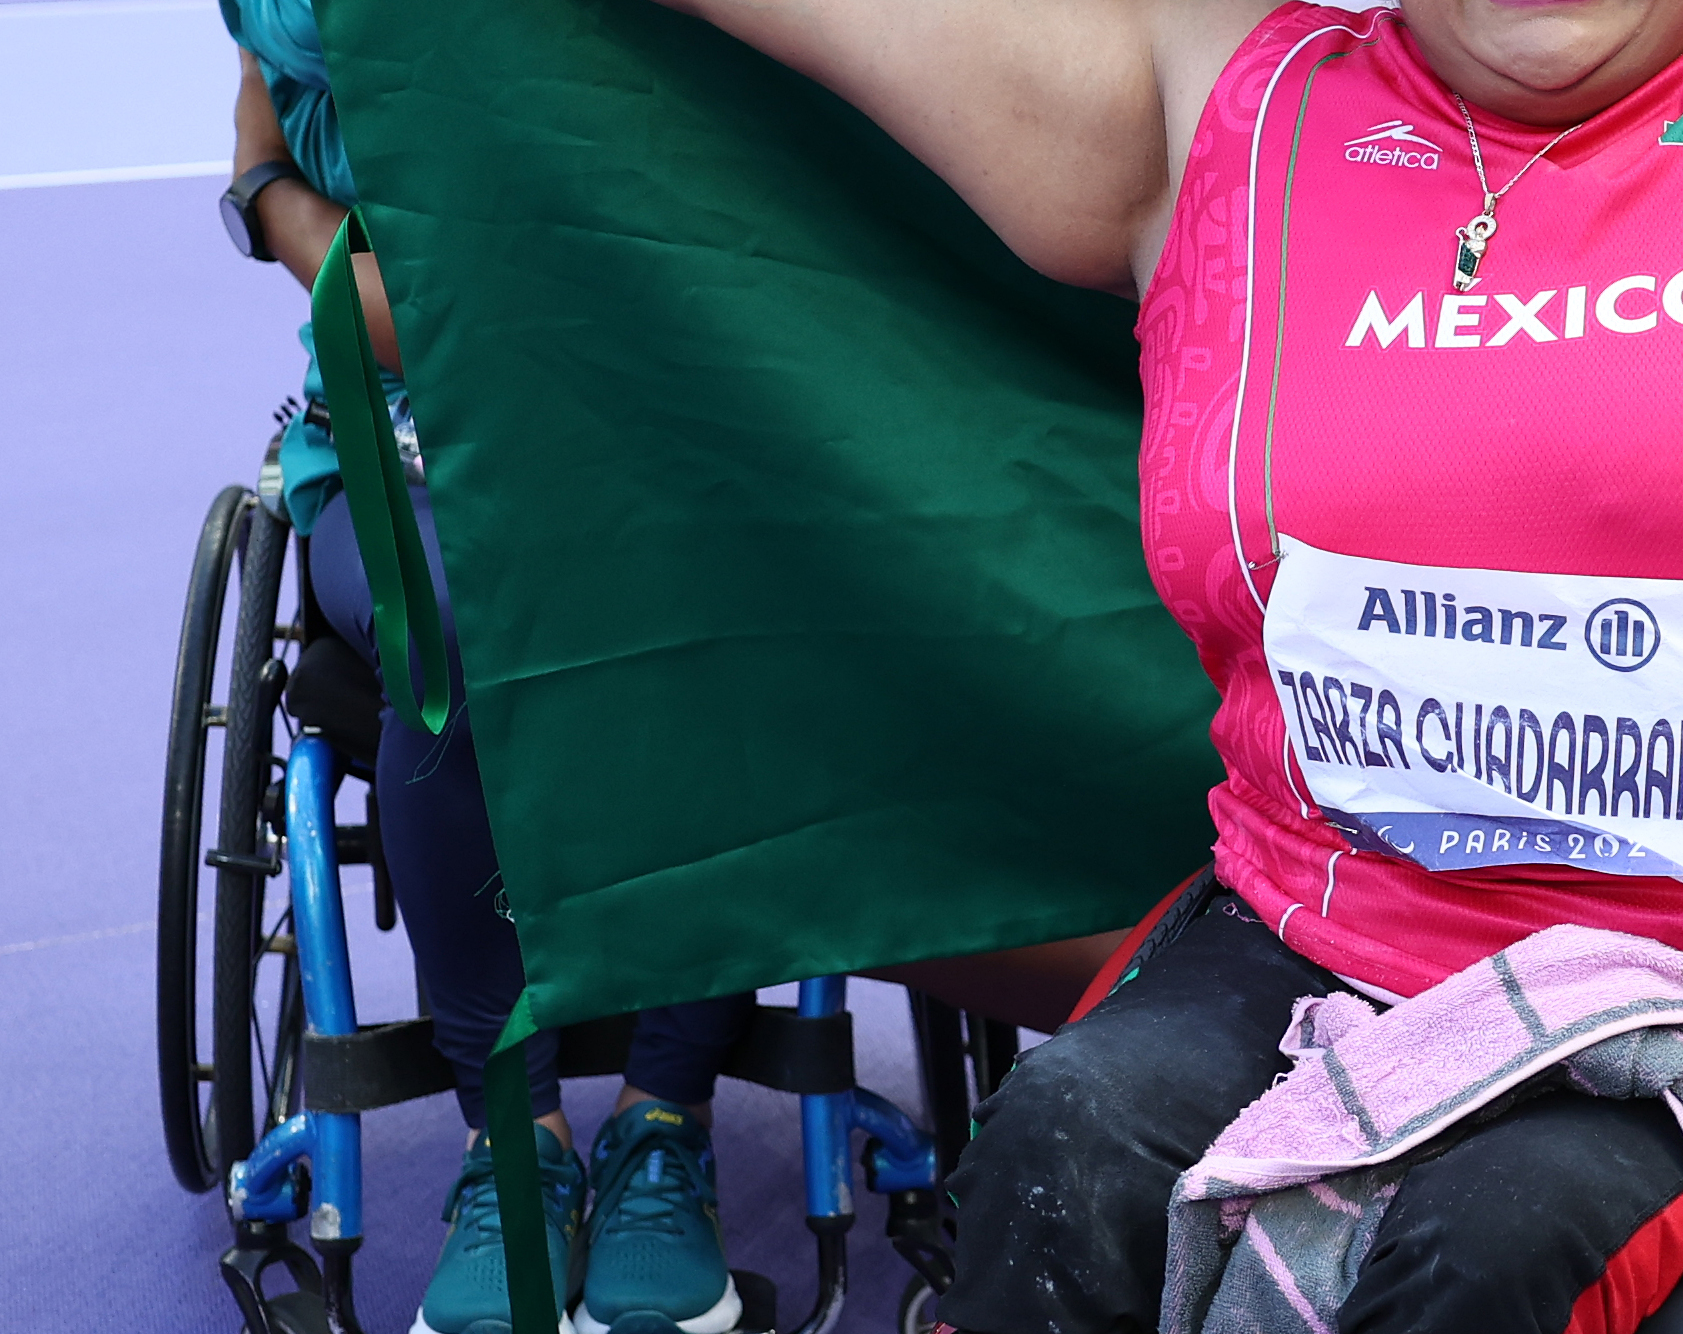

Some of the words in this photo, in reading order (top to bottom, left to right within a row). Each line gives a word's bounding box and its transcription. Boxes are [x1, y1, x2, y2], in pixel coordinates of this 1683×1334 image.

[1345, 145, 1439, 170] atletica
[1357, 586, 1568, 651] Allianz
[1279, 670, 1412, 770] ZARZA
